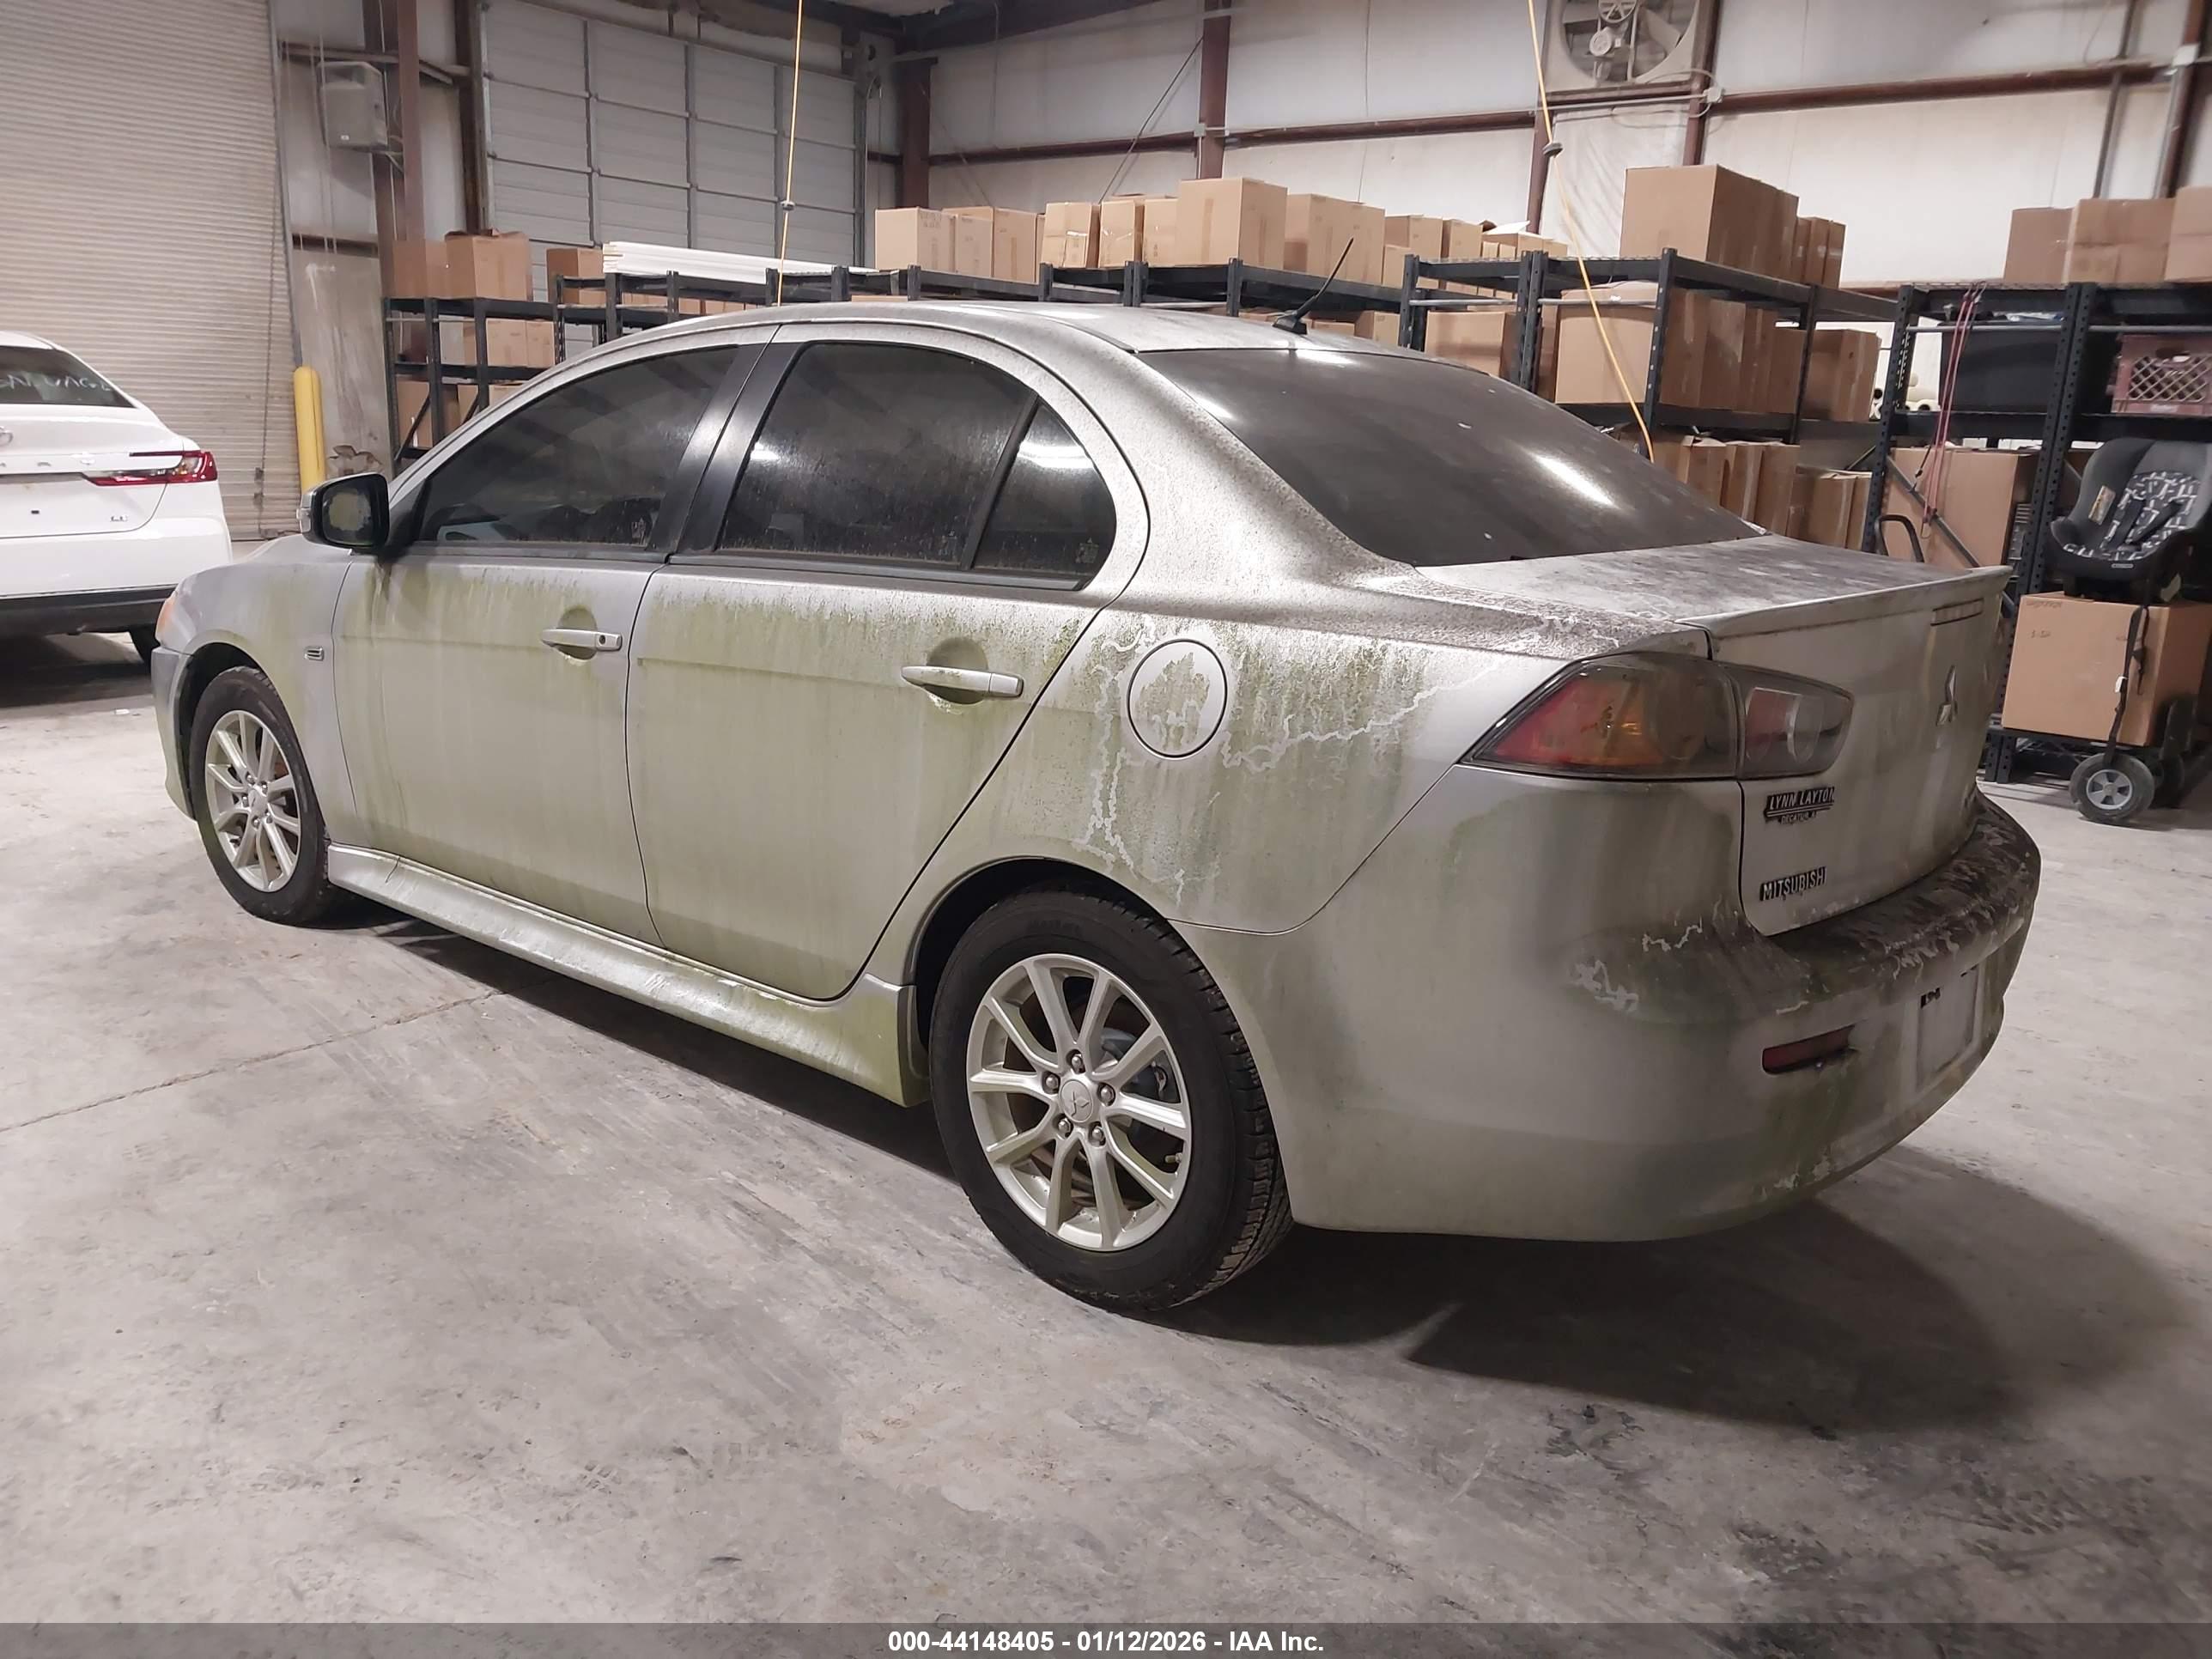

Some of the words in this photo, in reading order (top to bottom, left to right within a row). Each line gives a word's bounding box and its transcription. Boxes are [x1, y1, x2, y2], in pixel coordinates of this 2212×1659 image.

[1768, 792, 1796, 811] LYNN
[1799, 787, 1835, 805] LAYTON
[1760, 866, 1827, 901] MITSUBISHI
